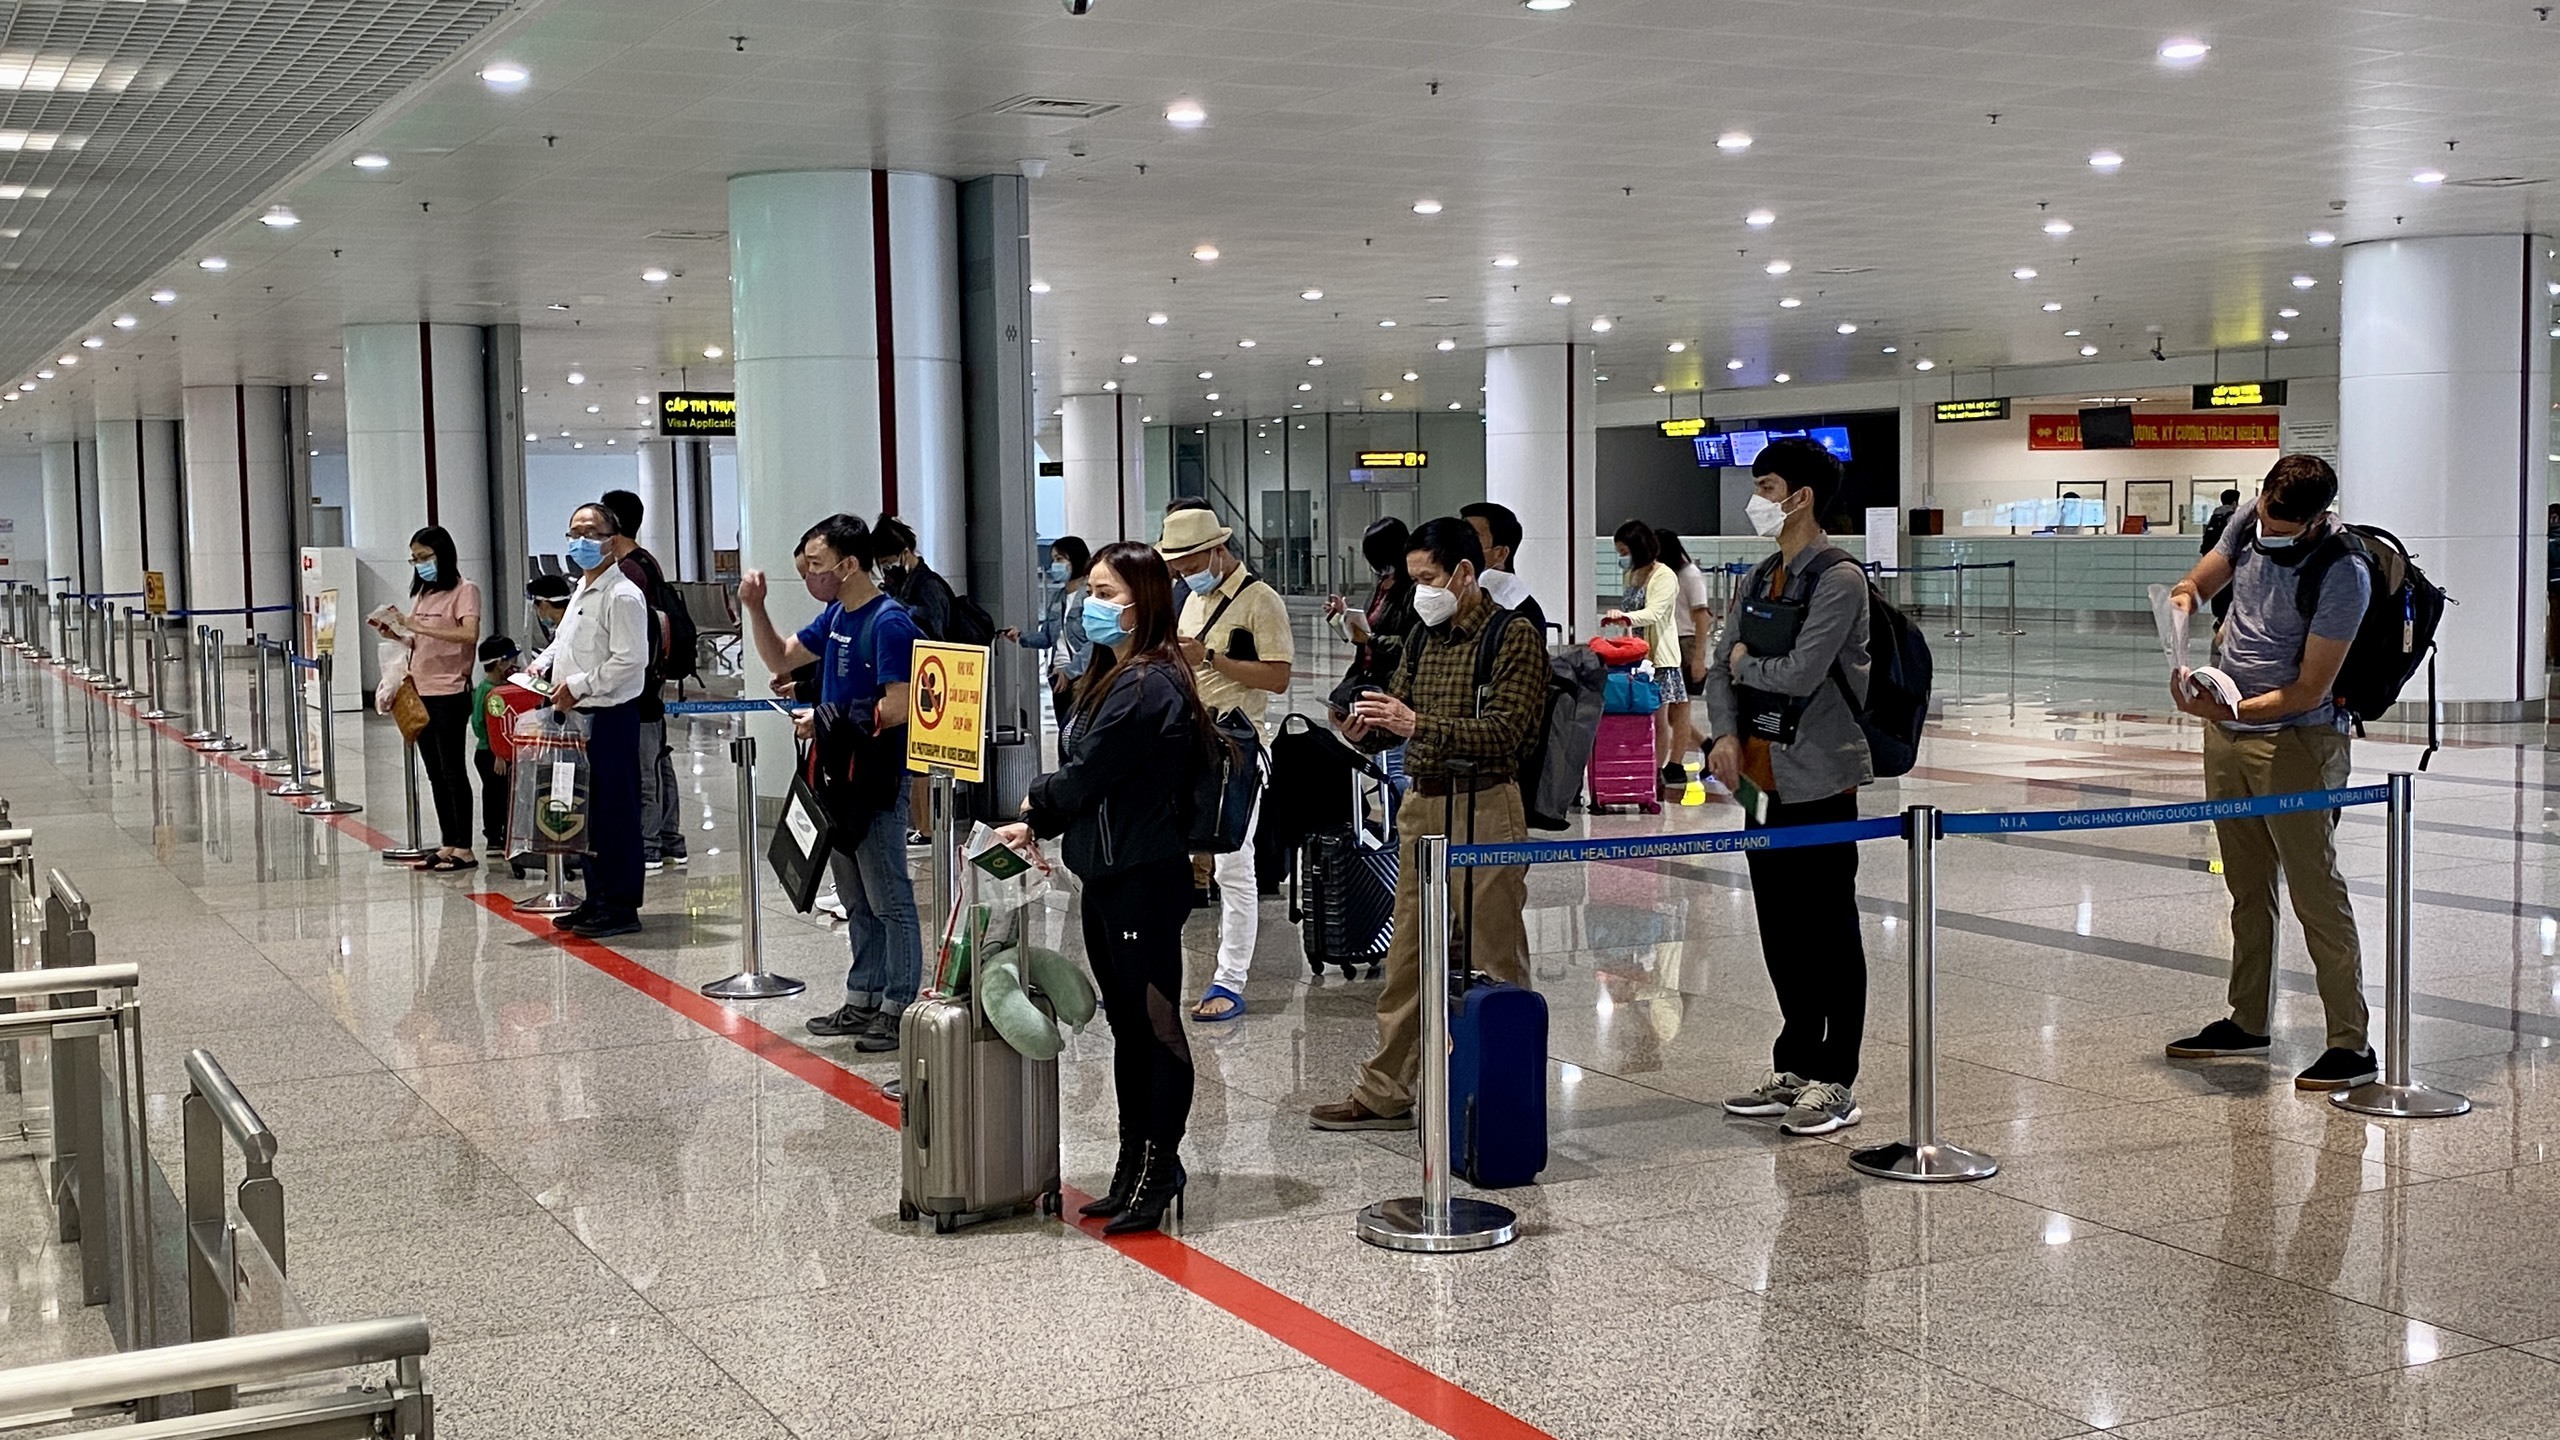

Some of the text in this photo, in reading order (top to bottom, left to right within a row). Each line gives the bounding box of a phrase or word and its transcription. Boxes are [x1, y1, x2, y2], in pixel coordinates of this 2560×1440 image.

[667, 418, 736, 429] Visa Applicatio
[2364, 787, 2389, 799] INTE
[2125, 808, 2164, 822] KHÔNG
[1451, 835, 1770, 865] FOR INTERNATIONAL HEALTH QUANRANTINE OF HANOI
